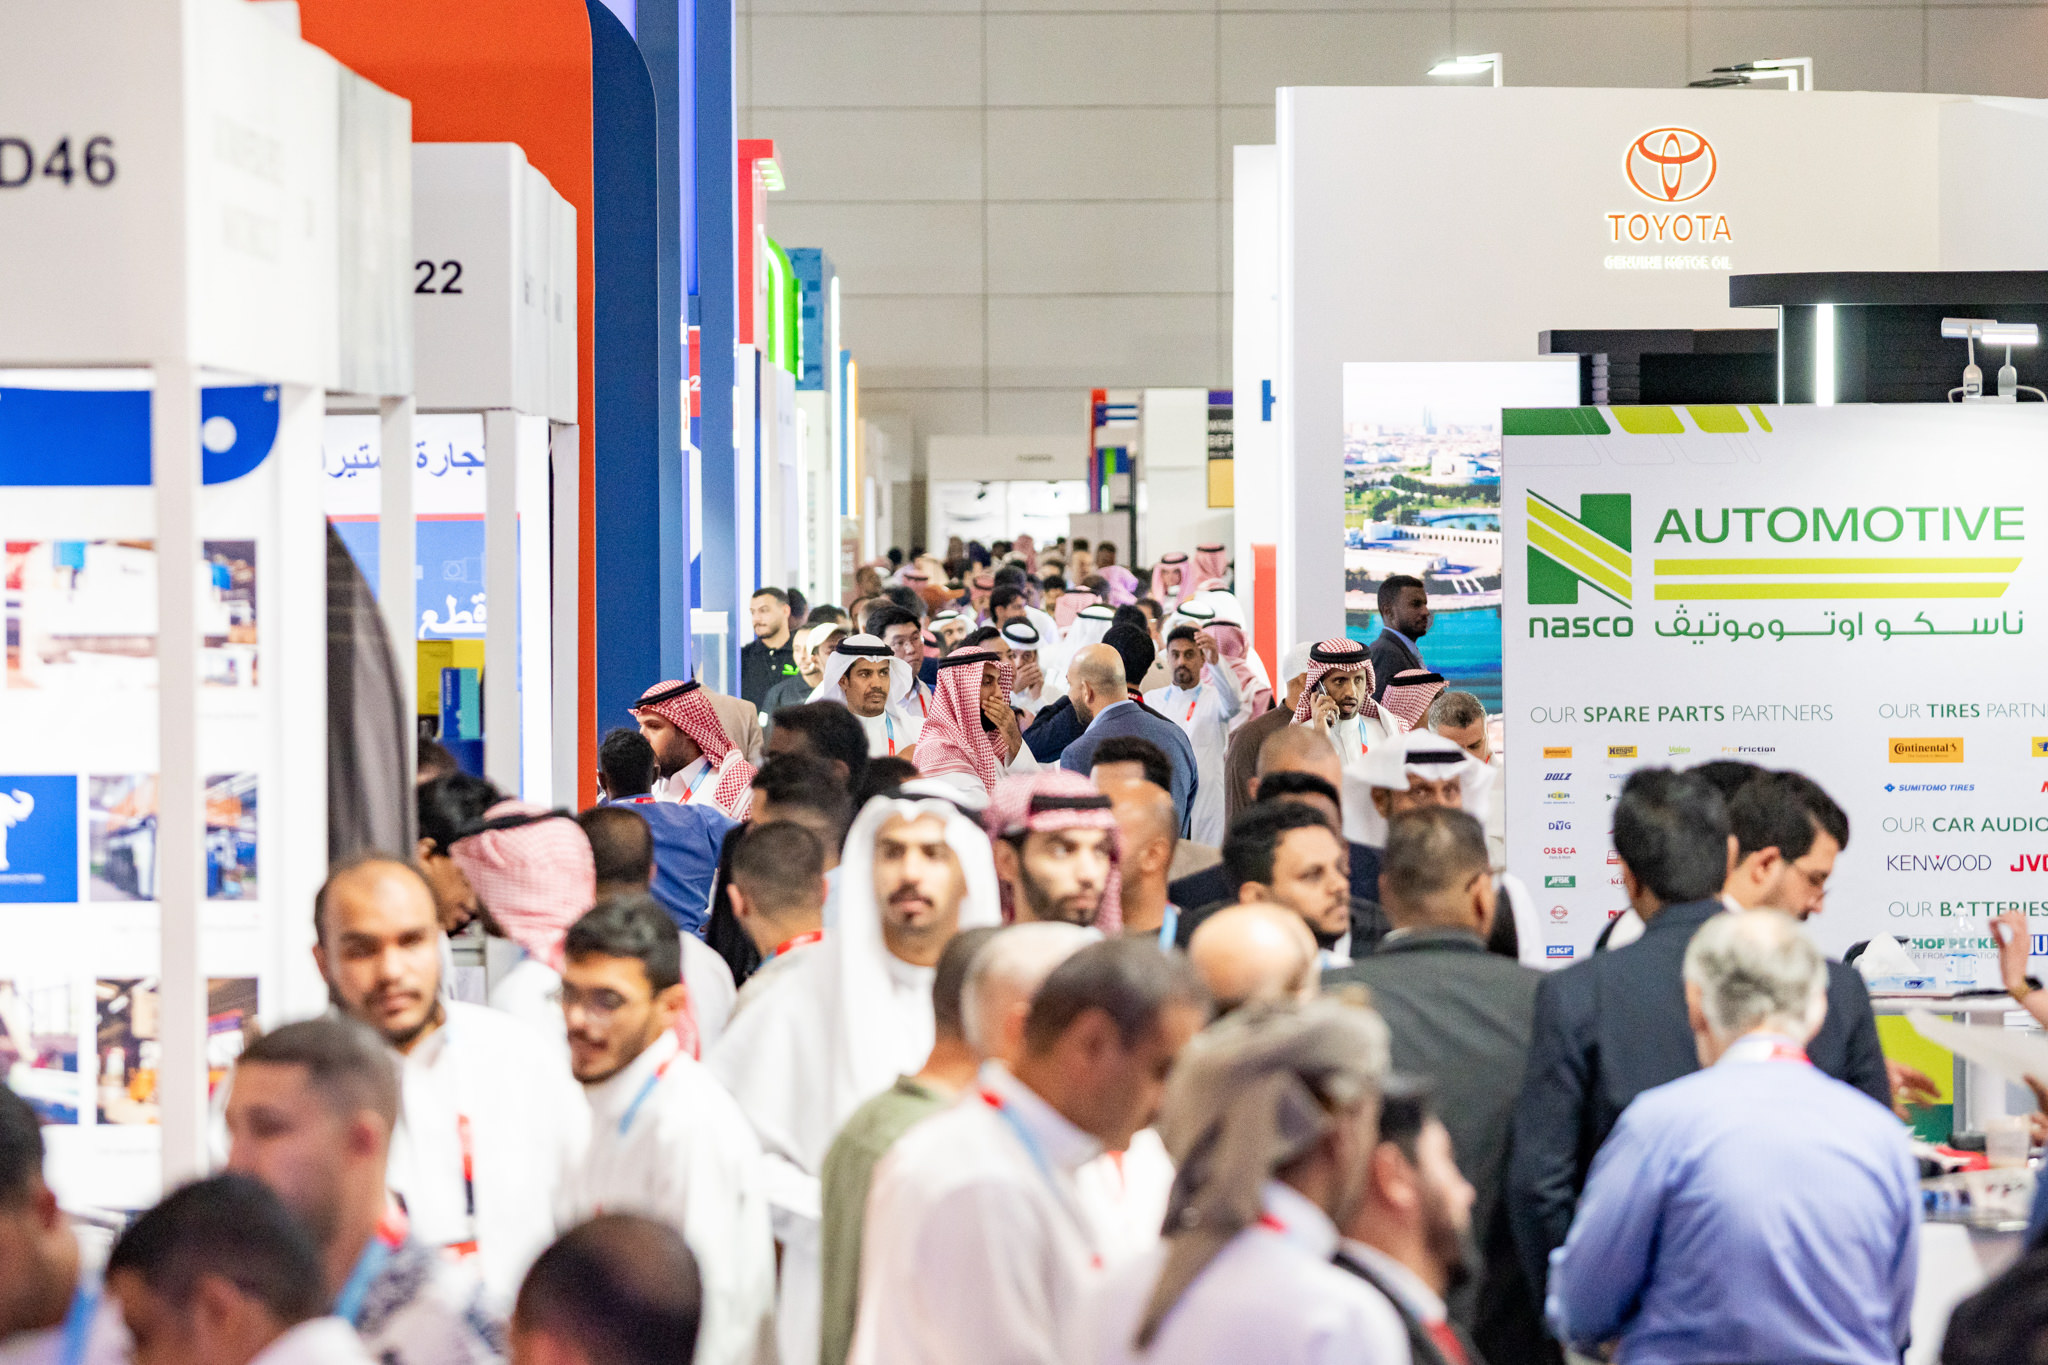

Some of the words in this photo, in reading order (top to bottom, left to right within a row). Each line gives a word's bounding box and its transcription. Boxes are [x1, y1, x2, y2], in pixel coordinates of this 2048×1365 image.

[1606, 213, 1732, 242] TOYOTA
[414, 260, 463, 294] 22
[1653, 506, 2025, 543] AUTOMOTIVE
[1529, 616, 1634, 638] nasco
[1875, 609, 2024, 641] ناسكو
[1530, 706, 1577, 723] OUR
[1584, 706, 1650, 722] SPARE
[1657, 705, 1725, 721] PARTS
[1732, 704, 1833, 722] PARTNERS
[1878, 703, 1920, 718] OUR
[1926, 703, 1980, 718] TIRES
[1894, 743, 1949, 755] Continental
[1899, 784, 1947, 792] SUMITOMO
[1949, 784, 1975, 792] TIRES
[1882, 817, 1926, 832] OUR
[1932, 817, 1975, 832] CAR
[1544, 847, 1576, 855] OSSCA
[1887, 855, 1992, 871] KENWOOD
[1888, 902, 1933, 917] OUR
